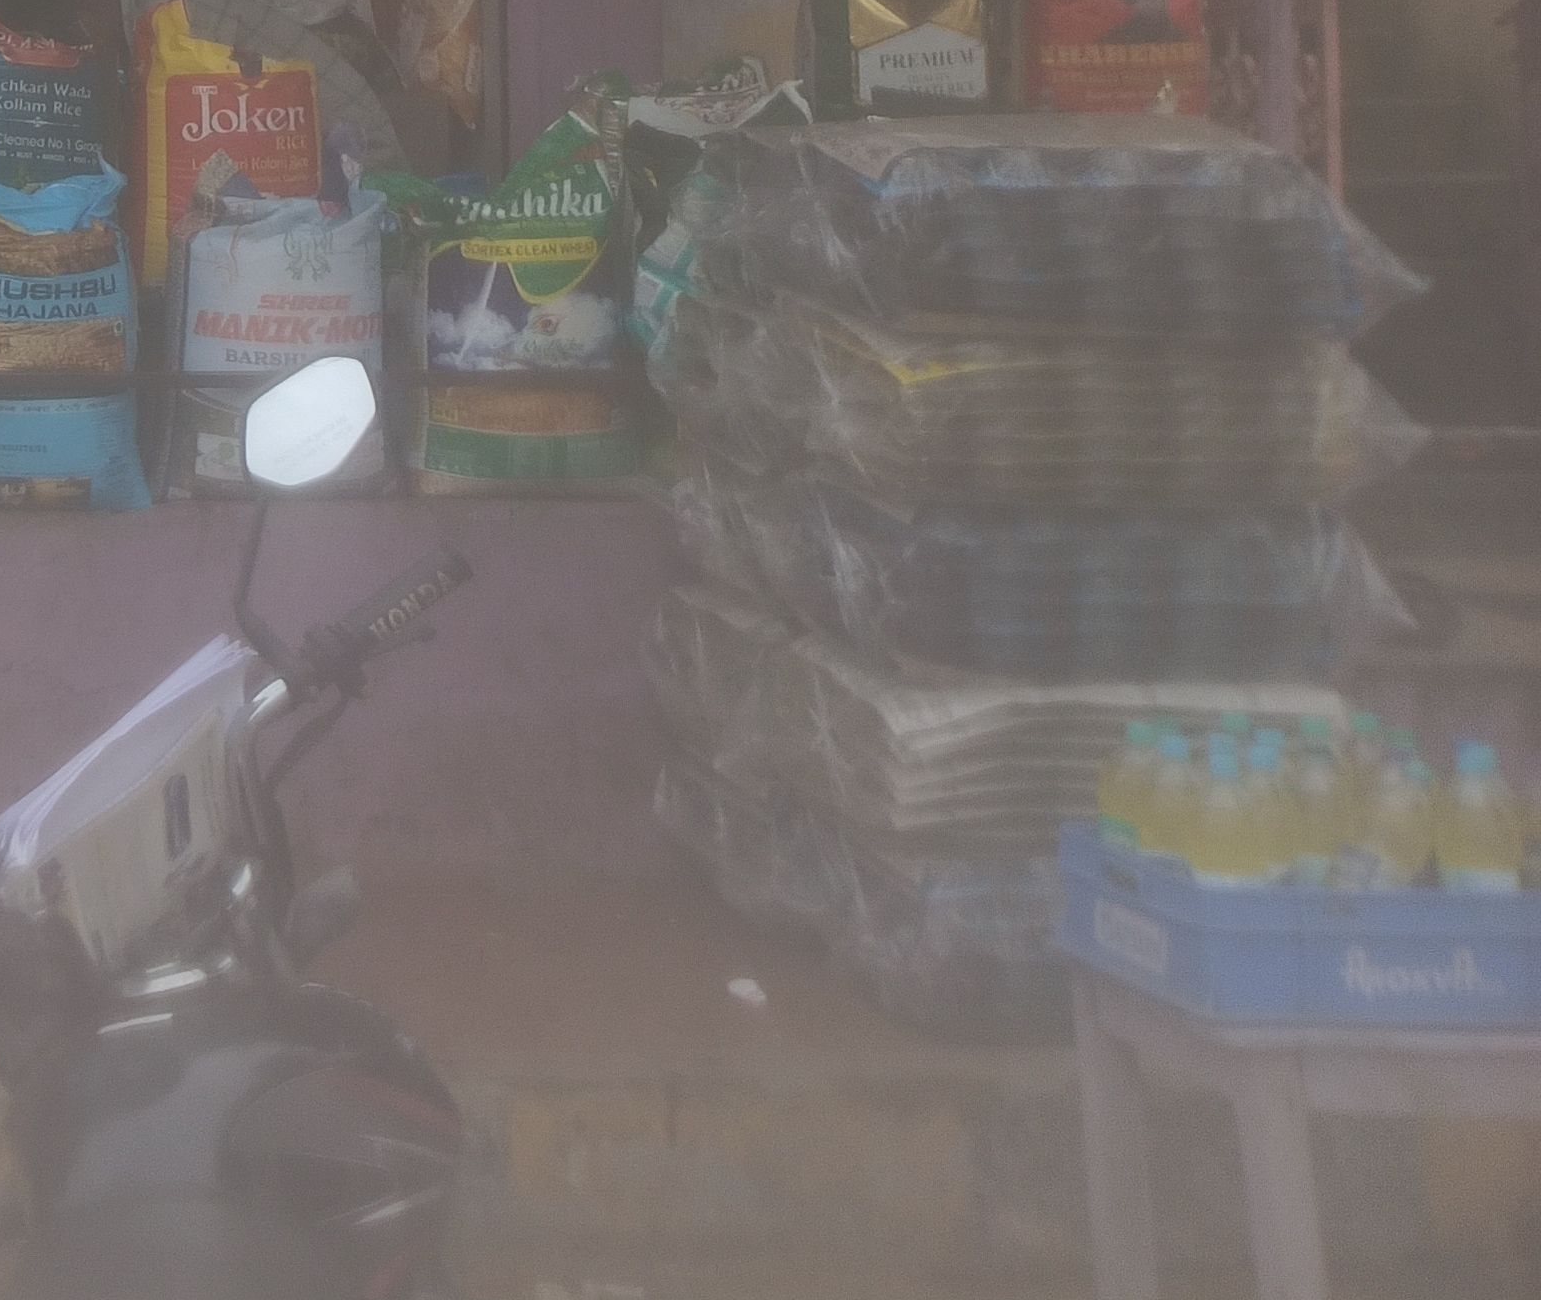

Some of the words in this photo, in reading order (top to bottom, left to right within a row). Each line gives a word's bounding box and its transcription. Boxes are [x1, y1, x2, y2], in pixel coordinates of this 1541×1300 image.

[879, 47, 976, 70] PREMIUM
[53, 81, 92, 99] Wada
[53, 100, 83, 117] Rice
[181, 84, 306, 142] Joker
[47, 136, 64, 150] No
[275, 135, 308, 151] RICE
[515, 243, 557, 257] CLEAN
[257, 293, 352, 312] SHREE
[367, 568, 452, 642] HONDA
